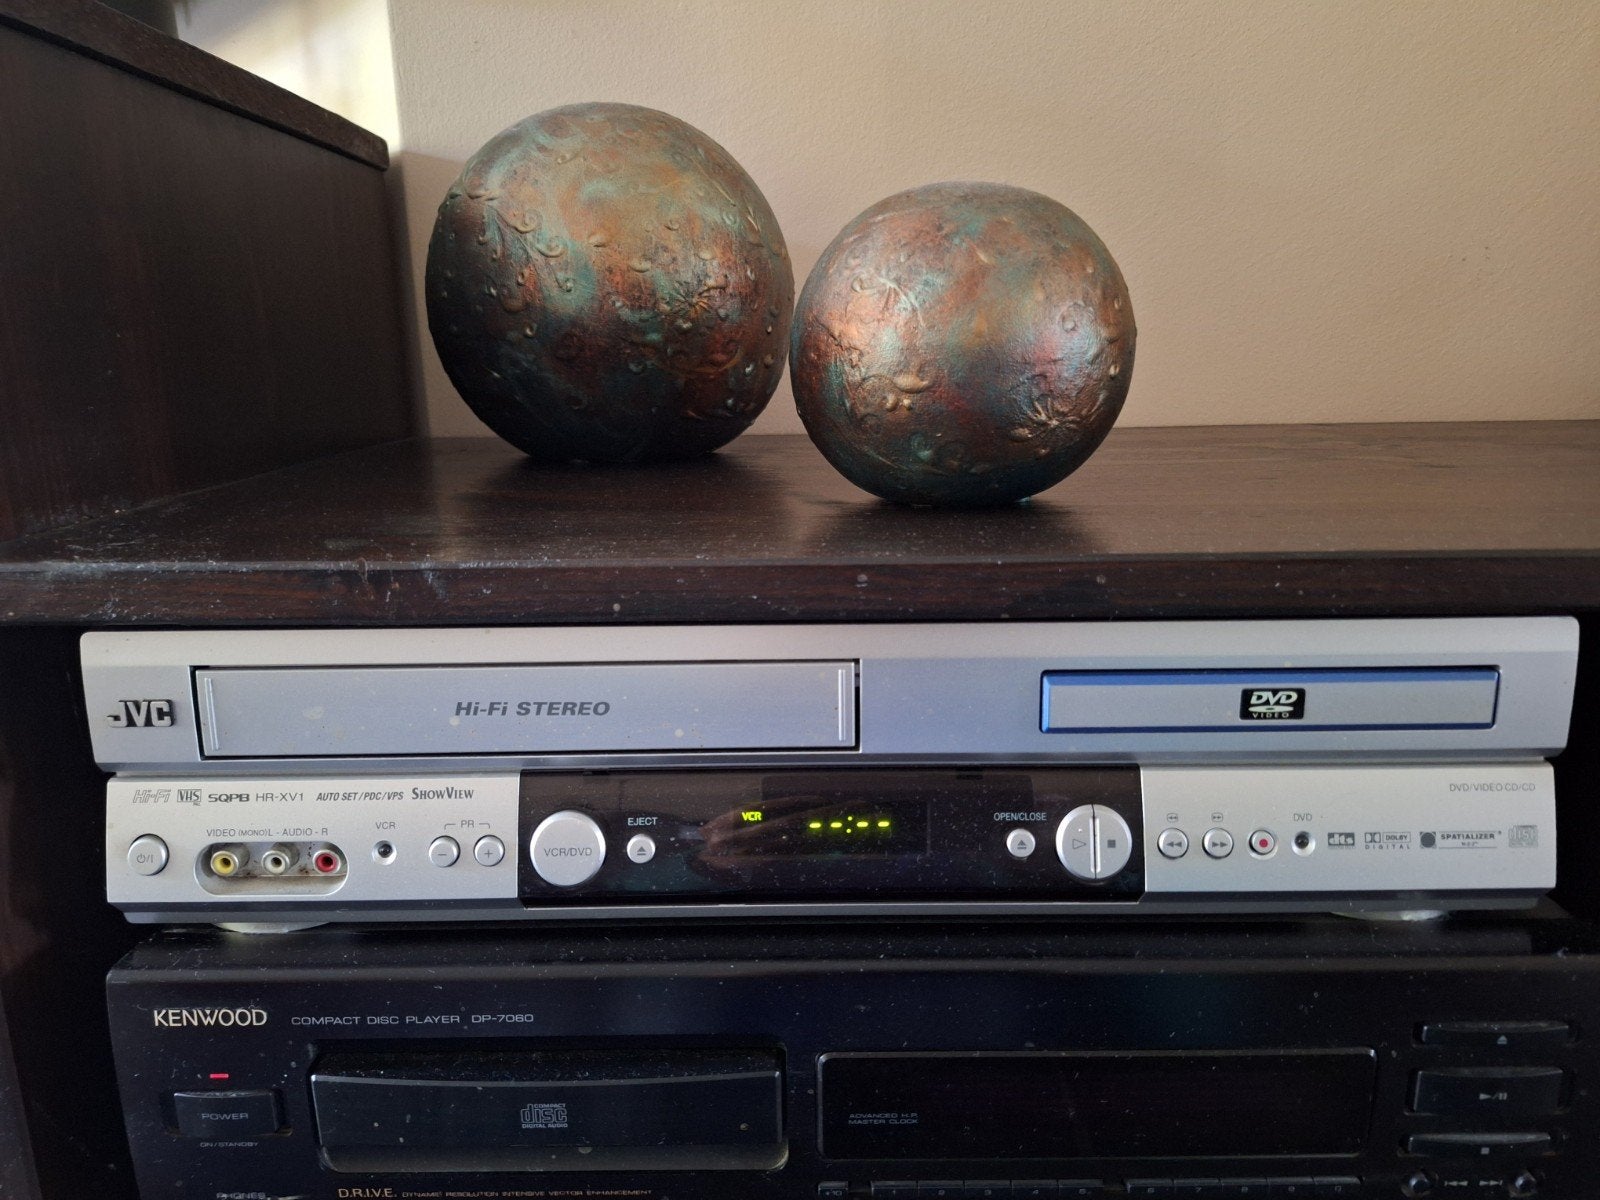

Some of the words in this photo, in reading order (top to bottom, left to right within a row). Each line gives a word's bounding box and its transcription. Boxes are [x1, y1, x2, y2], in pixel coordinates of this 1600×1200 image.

[1250, 691, 1298, 706] DVD
[107, 699, 175, 728] JVC
[454, 701, 508, 716] Hi-Fi
[516, 701, 611, 716] STEREO
[132, 789, 172, 803] Hi-Fi
[178, 789, 200, 802] VHS
[256, 793, 304, 802] HR-XV1
[316, 792, 340, 801] AUTO
[627, 817, 658, 826] EJECT
[741, 812, 762, 821] VCR
[993, 812, 1047, 822] OPEN/CLOSE
[1293, 813, 1313, 822] DVD
[375, 821, 396, 830] VCR
[460, 820, 475, 828] PR
[206, 829, 236, 837] VIDEO
[283, 828, 313, 836] AUDIO
[544, 848, 593, 858] VCR/DVD
[153, 1009, 268, 1027] KENWOOD
[291, 1016, 361, 1026] COMPACT
[367, 1016, 399, 1025] DISC
[406, 1015, 460, 1024] PLAYER
[471, 1014, 534, 1023] DP-7060
[201, 1112, 249, 1120] POWER
[338, 1188, 397, 1198] D.R.I.V.E.
